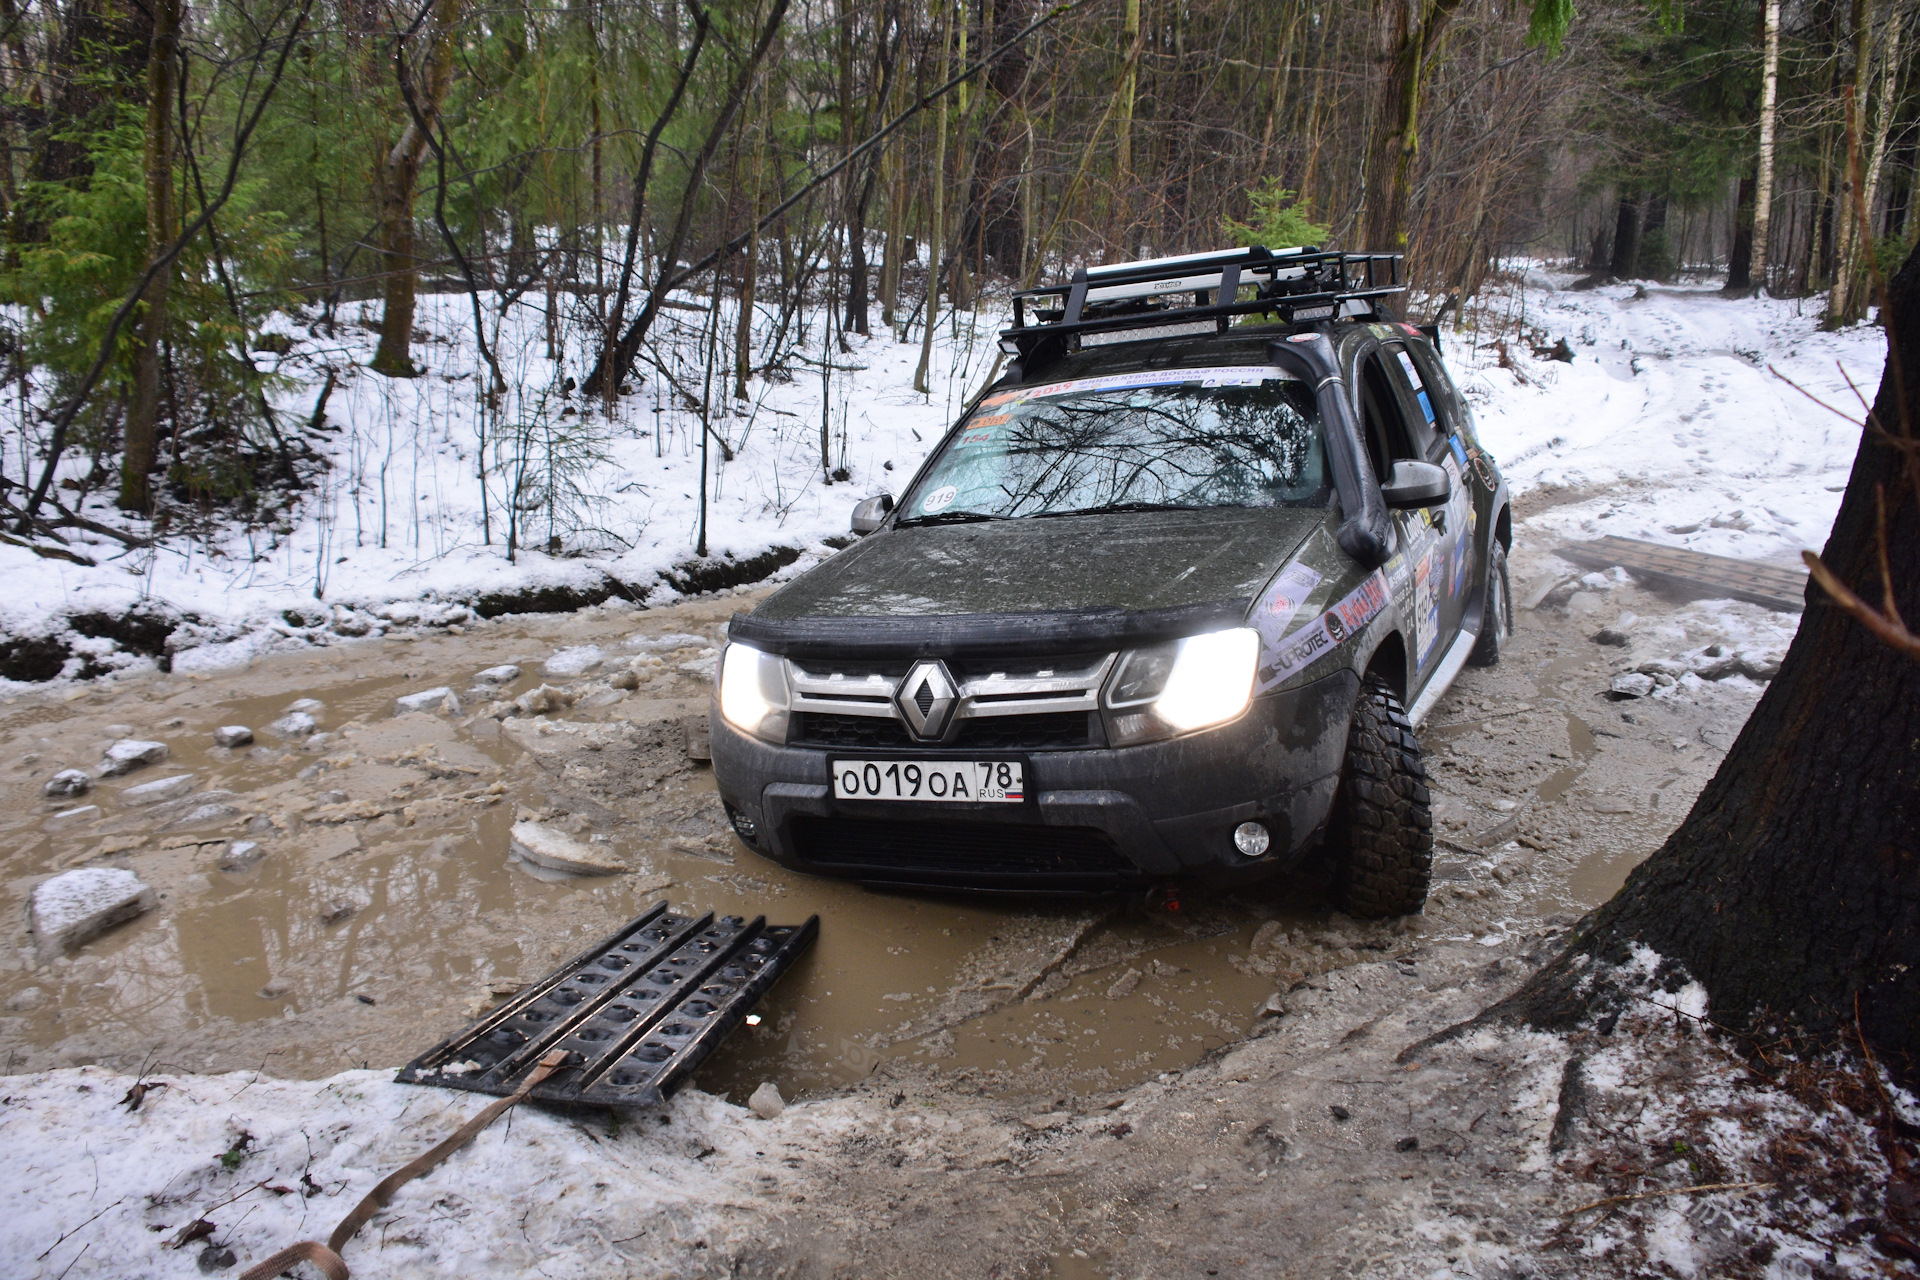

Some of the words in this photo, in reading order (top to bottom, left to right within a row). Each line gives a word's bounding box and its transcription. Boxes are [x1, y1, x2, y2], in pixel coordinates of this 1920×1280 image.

[1033, 382, 1073, 397] 2019
[1078, 376, 1118, 386] ФИНАЛ
[1121, 372, 1157, 382] КУБКА
[1214, 366, 1265, 375] РОССИИ
[963, 433, 990, 445] 154
[925, 491, 955, 506] 919
[1271, 630, 1328, 670] SUPROTEC
[978, 763, 1012, 789] 78
[979, 788, 1004, 799] RUS
